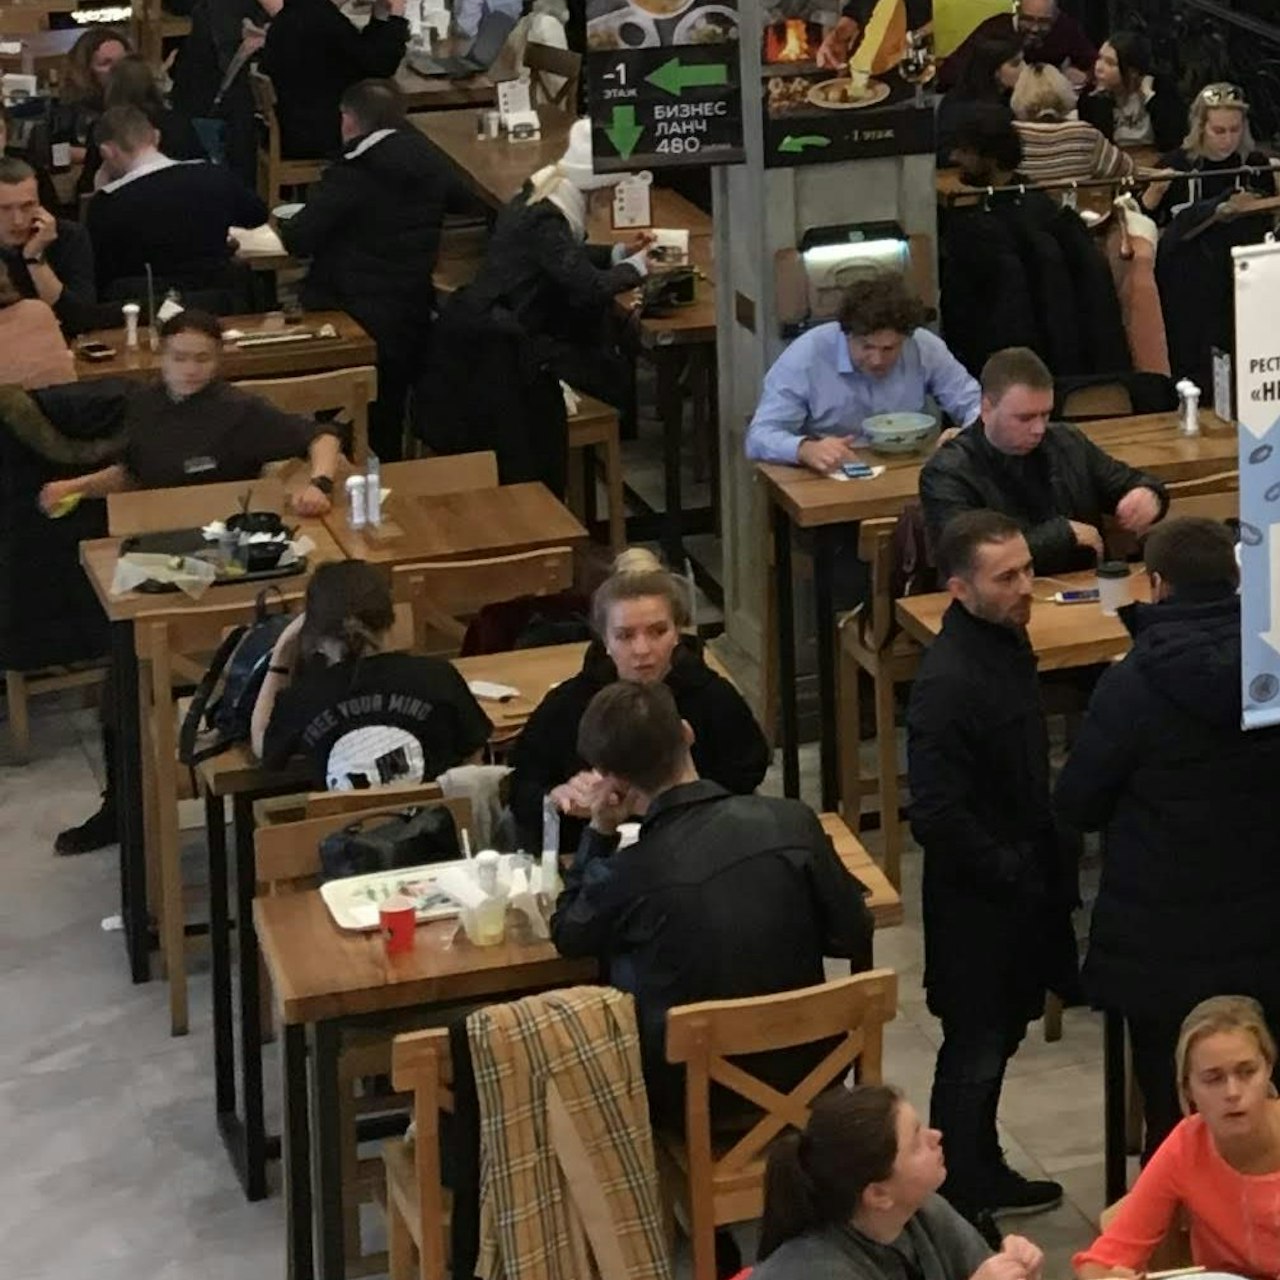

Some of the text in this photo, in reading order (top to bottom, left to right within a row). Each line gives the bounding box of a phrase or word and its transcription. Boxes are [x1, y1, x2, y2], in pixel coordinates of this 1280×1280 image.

[602, 62, 626, 85] -1
[654, 101, 727, 119] БИЗНЕС
[655, 120, 707, 136] ЛАНЧ
[655, 136, 700, 154] 480
[337, 693, 383, 718] YOUR
[388, 693, 433, 721] MIND
